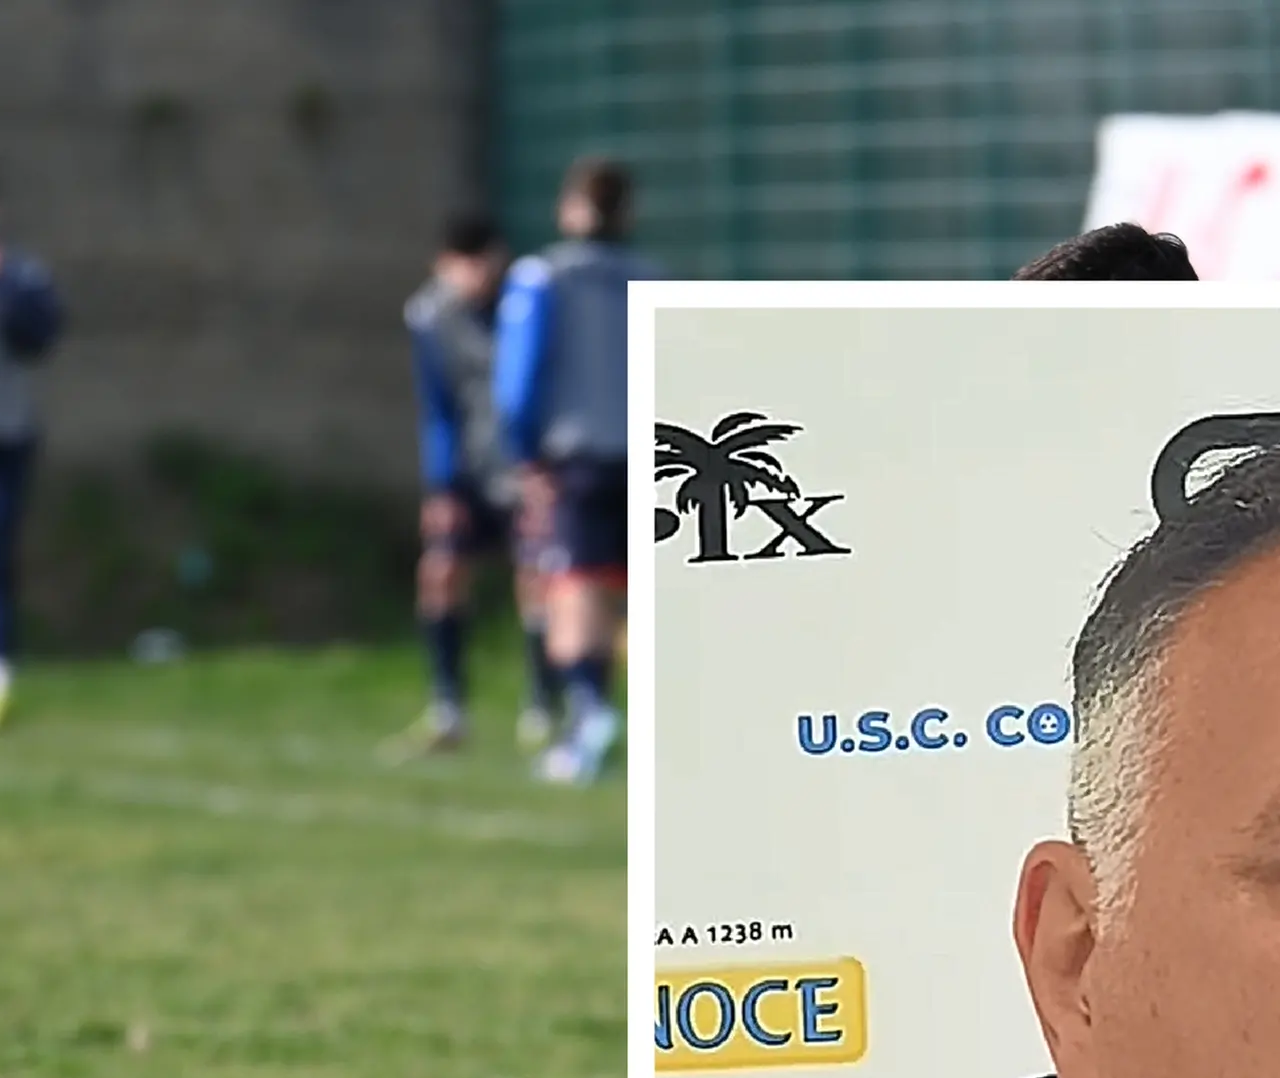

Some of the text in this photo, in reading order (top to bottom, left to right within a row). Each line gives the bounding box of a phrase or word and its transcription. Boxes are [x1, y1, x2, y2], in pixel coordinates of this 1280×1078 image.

[797, 703, 1071, 754] U.S.C. CO
[682, 927, 699, 945] A
[707, 922, 762, 944] 1238
[772, 924, 793, 940] m
